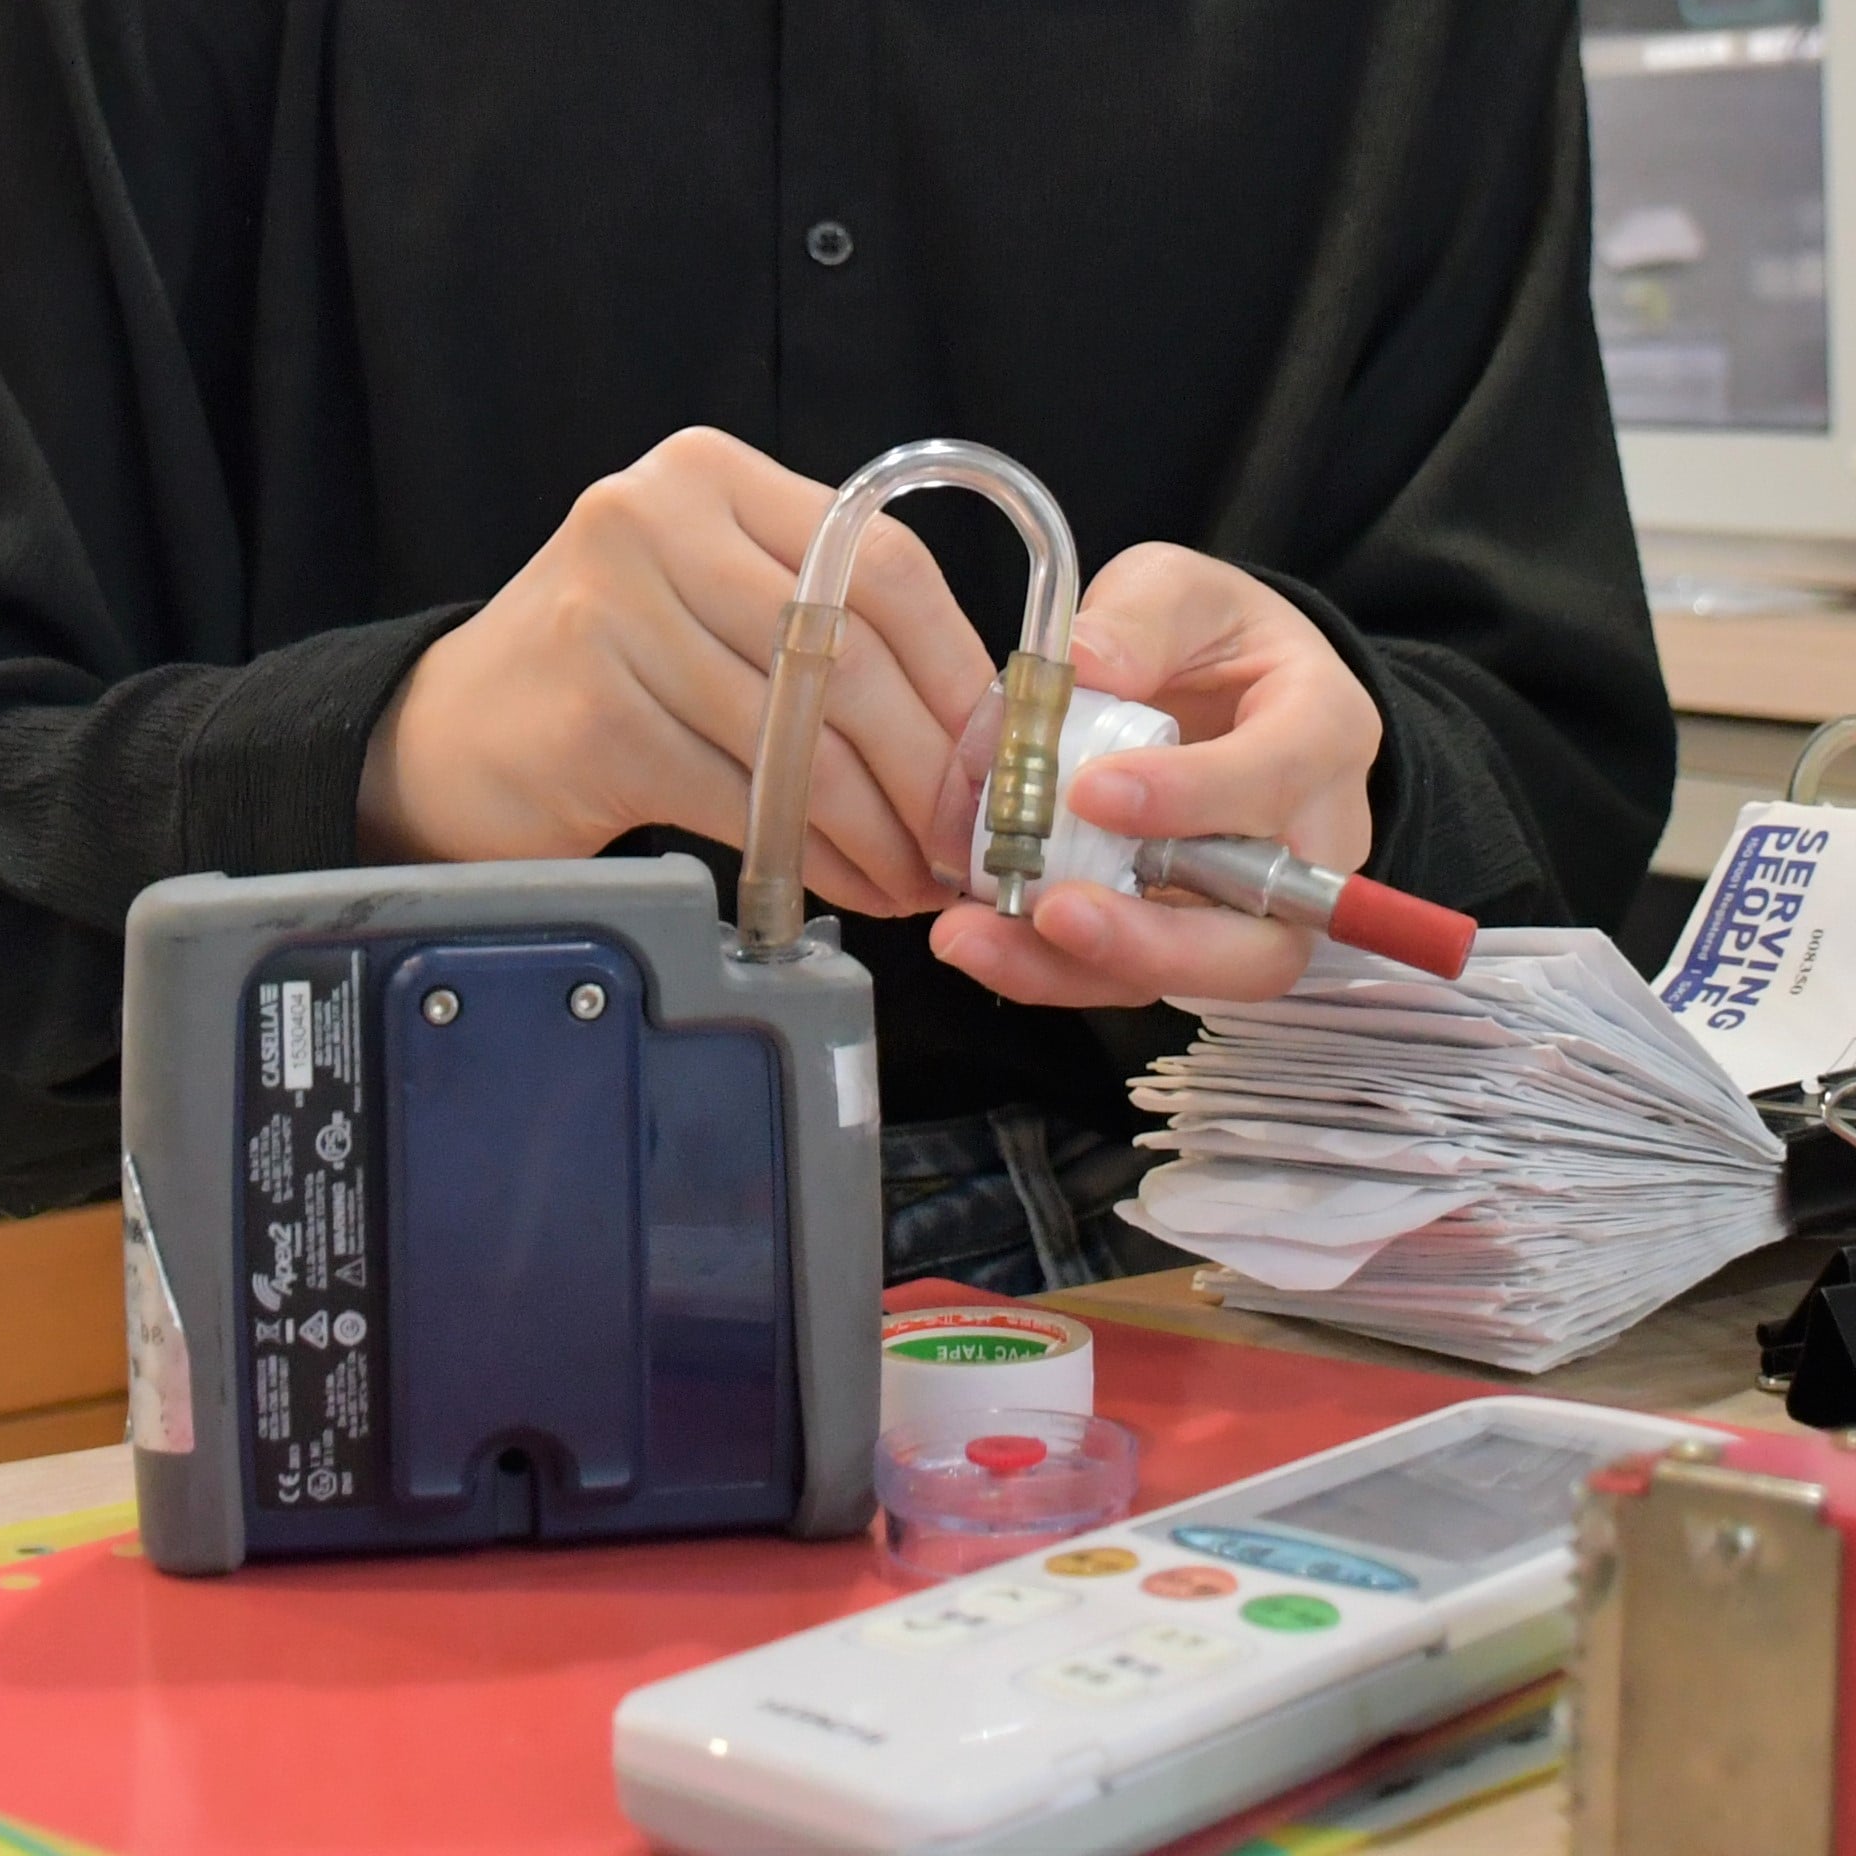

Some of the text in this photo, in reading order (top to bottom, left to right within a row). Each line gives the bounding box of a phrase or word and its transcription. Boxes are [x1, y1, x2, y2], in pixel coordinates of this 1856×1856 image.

[1696, 891, 1736, 962] Registered
[1697, 826, 1801, 1008] PEOPLE
[1705, 827, 1830, 1031] SERVING
[260, 1000, 282, 1088] CASELLA
[292, 992, 306, 1072] 1530404
[268, 1221, 295, 1297] Apex2
[936, 1344, 984, 1361] TAPE
